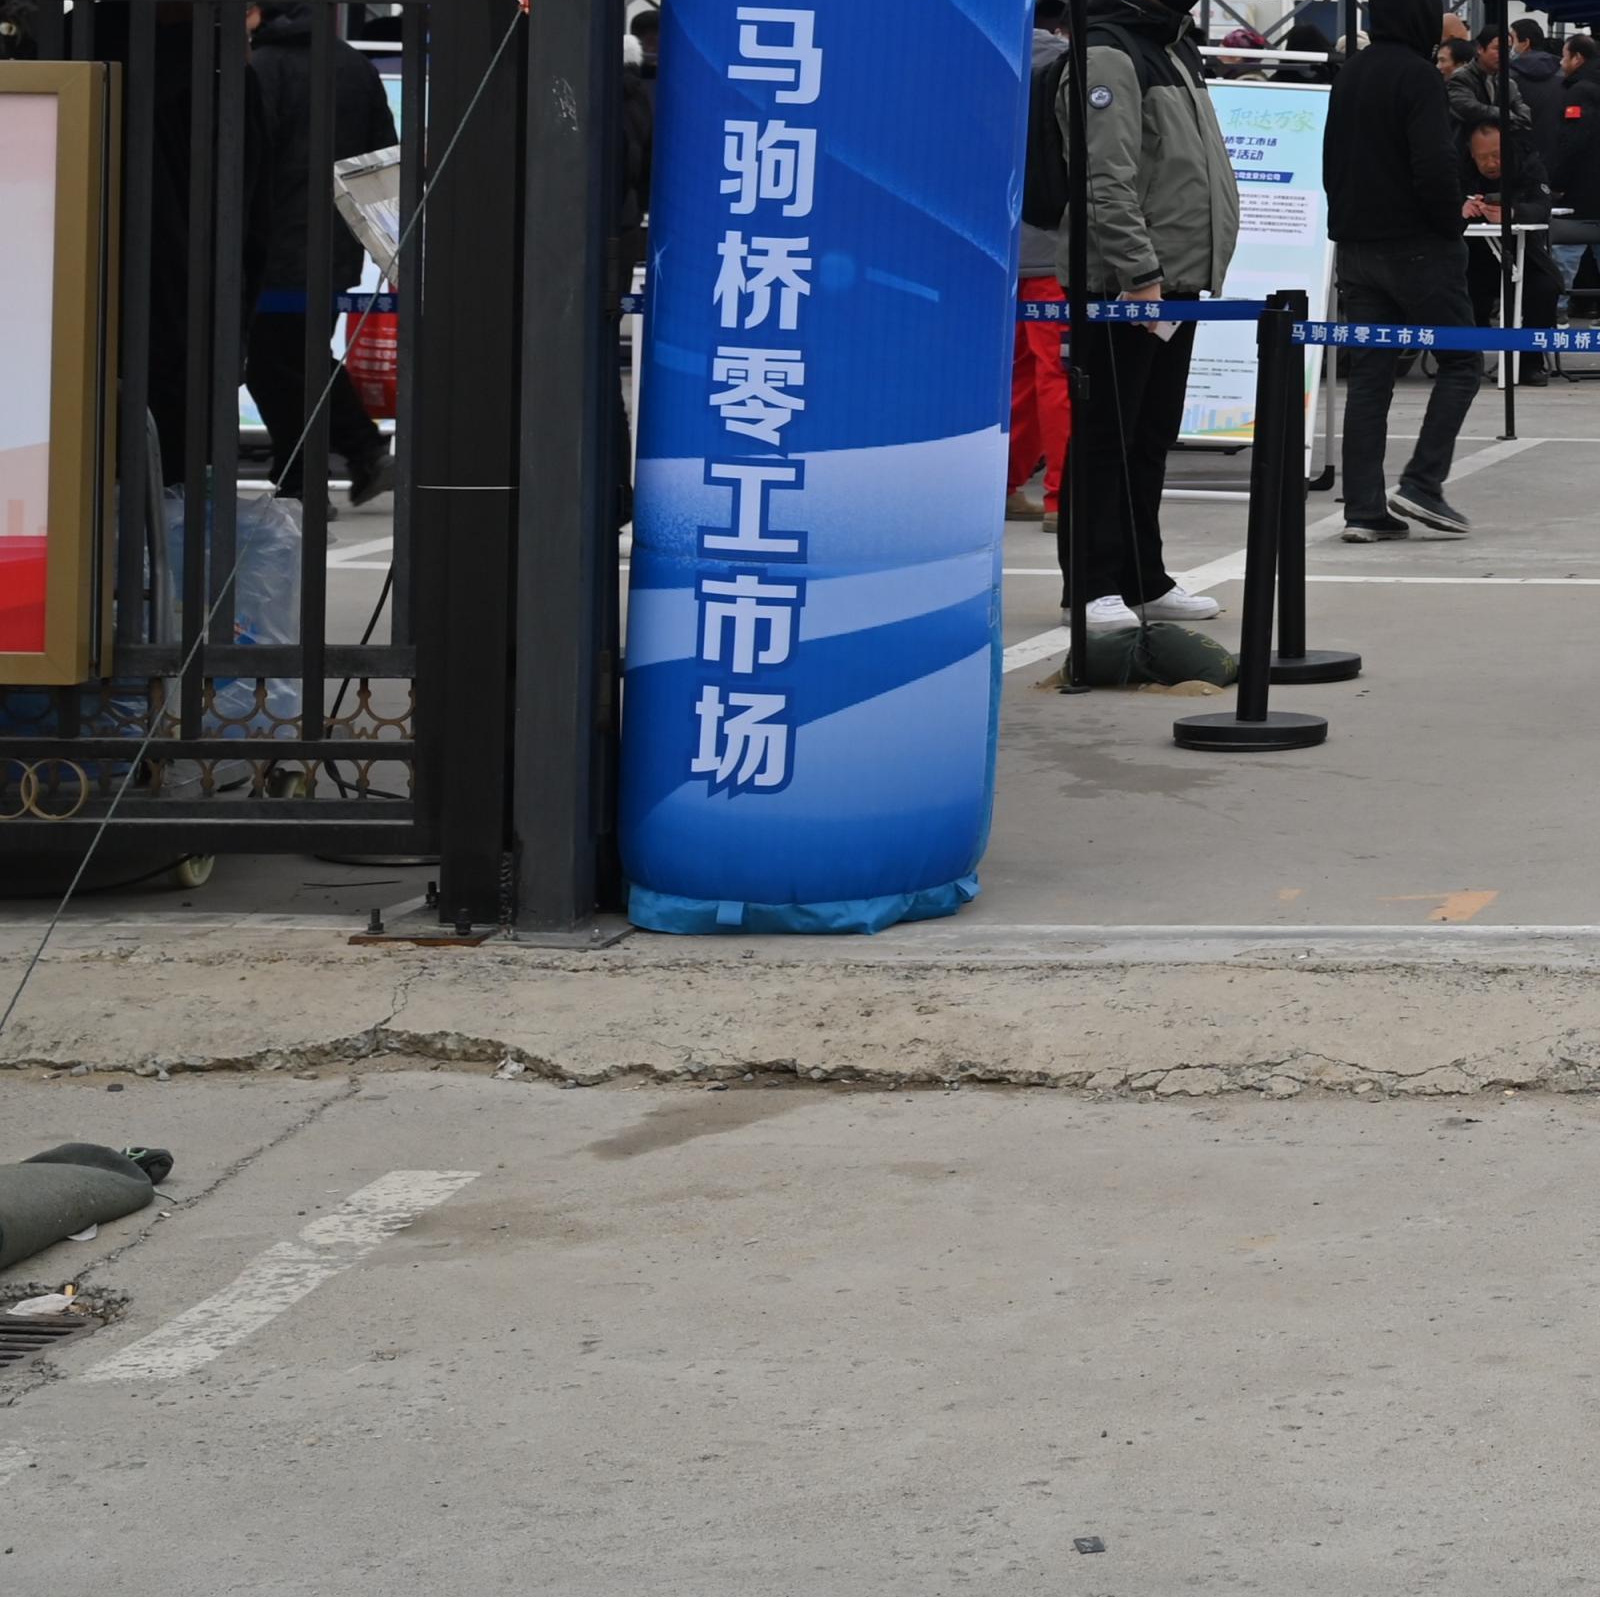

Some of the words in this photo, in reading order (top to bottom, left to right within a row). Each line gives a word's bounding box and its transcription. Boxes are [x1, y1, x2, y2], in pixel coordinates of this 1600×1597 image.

[1221, 135, 1278, 147] 桥零工市场
[1291, 323, 1436, 346] 马驹桥零工市场
